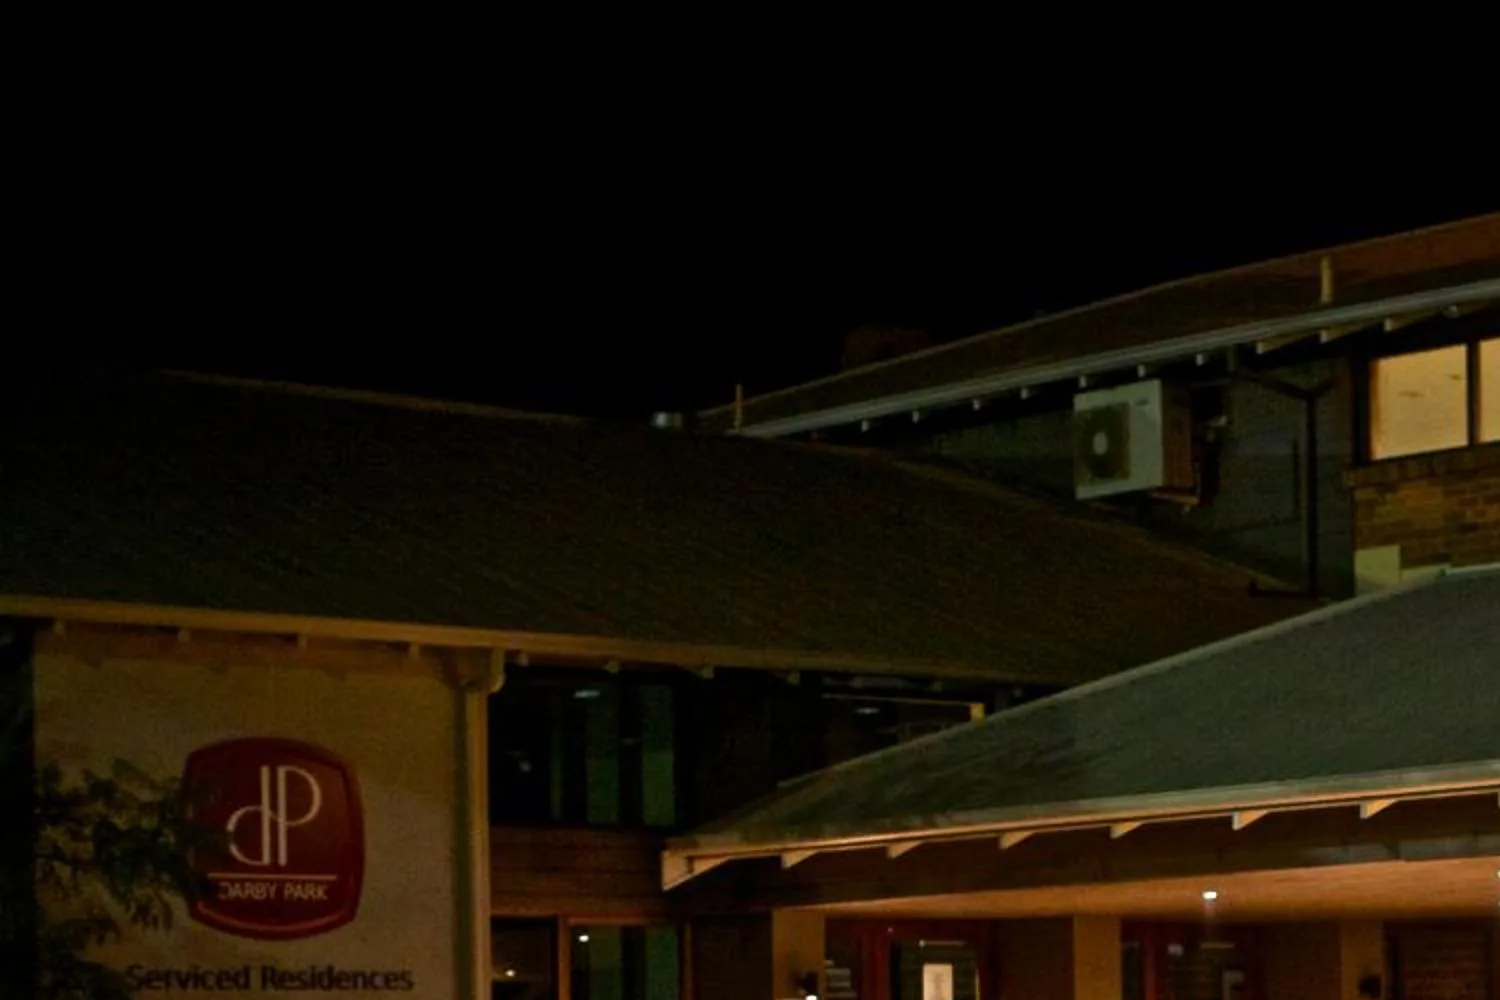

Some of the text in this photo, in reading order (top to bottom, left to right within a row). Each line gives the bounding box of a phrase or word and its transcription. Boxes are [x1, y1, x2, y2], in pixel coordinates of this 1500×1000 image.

[283, 881, 329, 901] PARK
[125, 964, 414, 991] Serviced Residences
